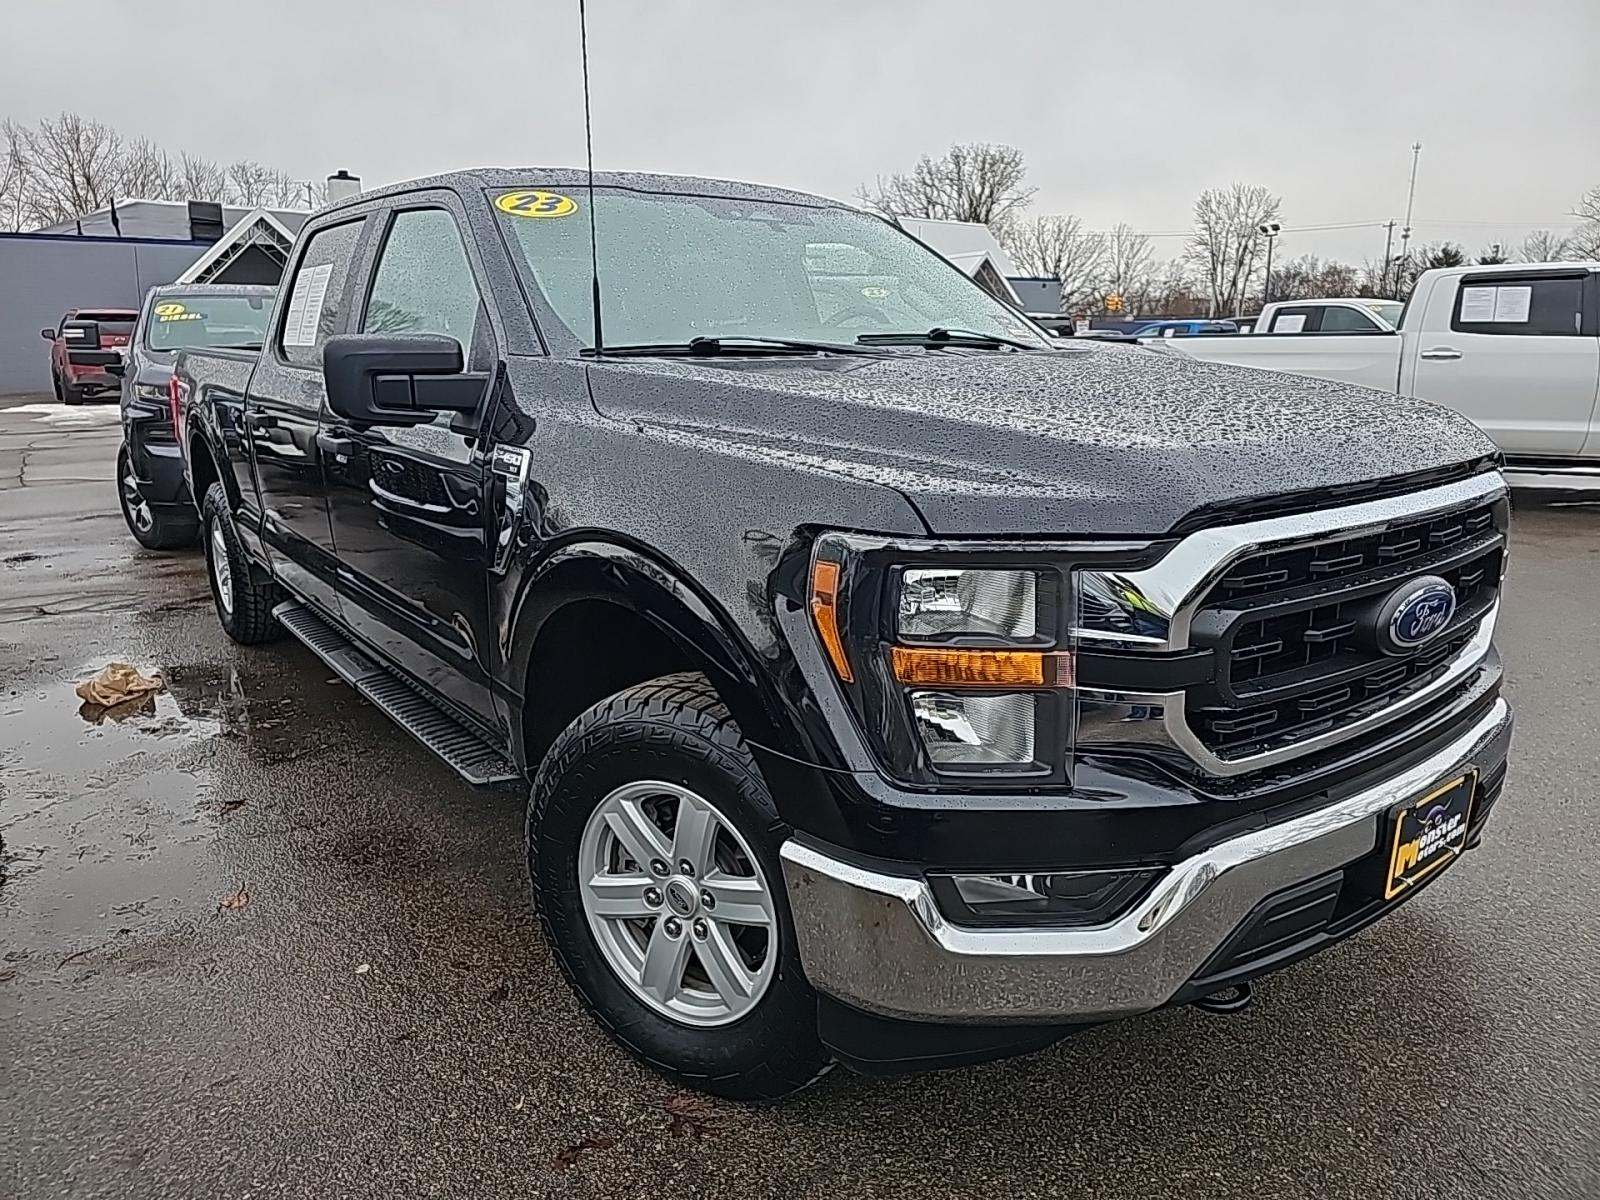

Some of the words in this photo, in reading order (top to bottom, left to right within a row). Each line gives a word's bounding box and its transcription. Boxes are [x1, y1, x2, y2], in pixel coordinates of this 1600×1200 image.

[509, 193, 564, 212] 23
[160, 313, 203, 322] DIESEL
[1410, 599, 1447, 636] Ford
